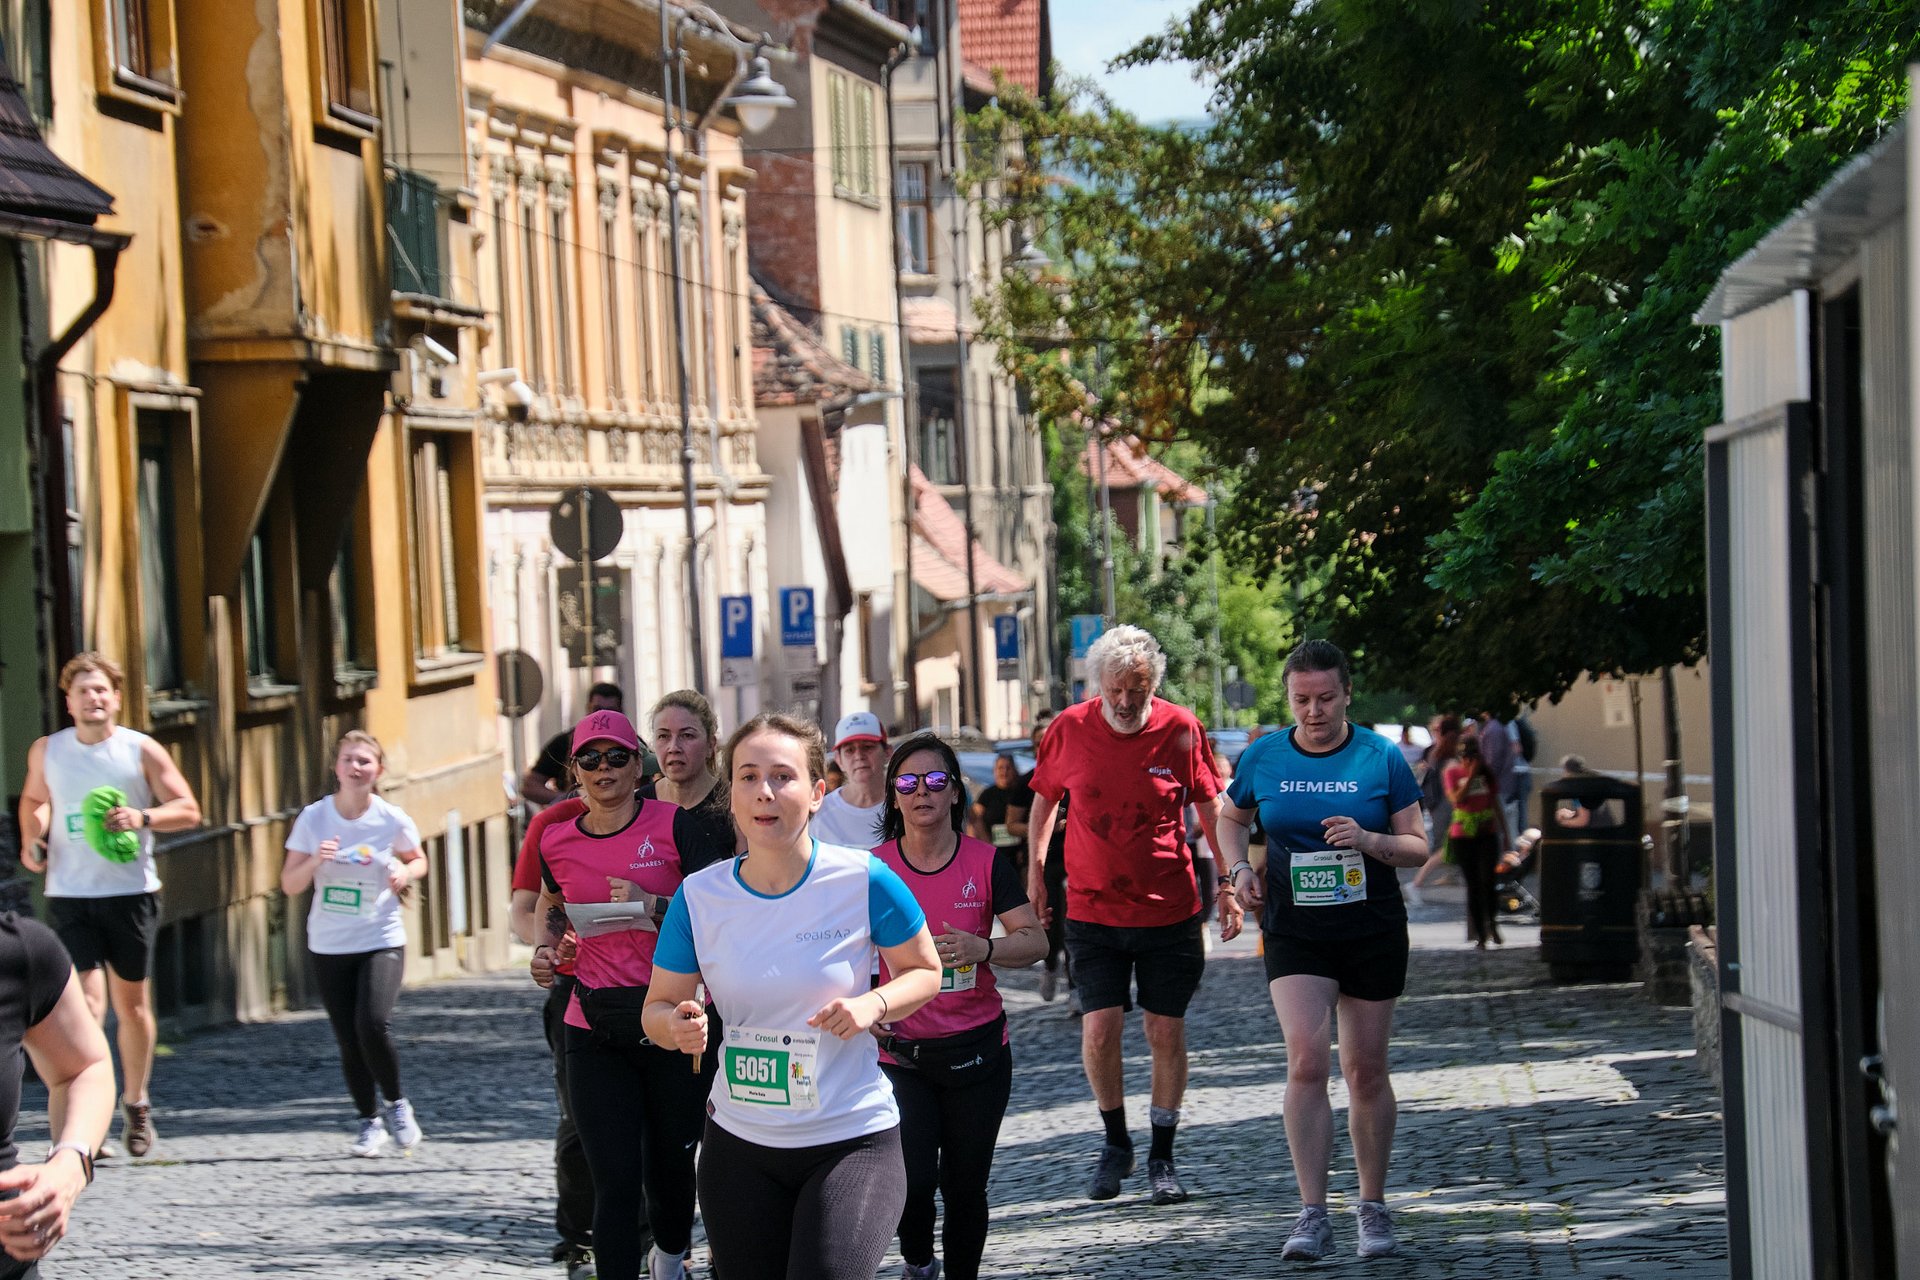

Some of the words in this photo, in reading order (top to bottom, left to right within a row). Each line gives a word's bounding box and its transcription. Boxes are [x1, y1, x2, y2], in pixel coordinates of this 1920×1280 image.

[727, 600, 748, 637] P
[789, 591, 809, 627] P
[1001, 617, 1015, 646] P
[1279, 780, 1359, 793] SIEMENS
[629, 859, 665, 870] SOMAREST
[1299, 870, 1337, 889] 5325
[953, 901, 985, 909] SOMAREST
[755, 1033, 778, 1044] Crosul
[735, 1055, 777, 1084] 5051
